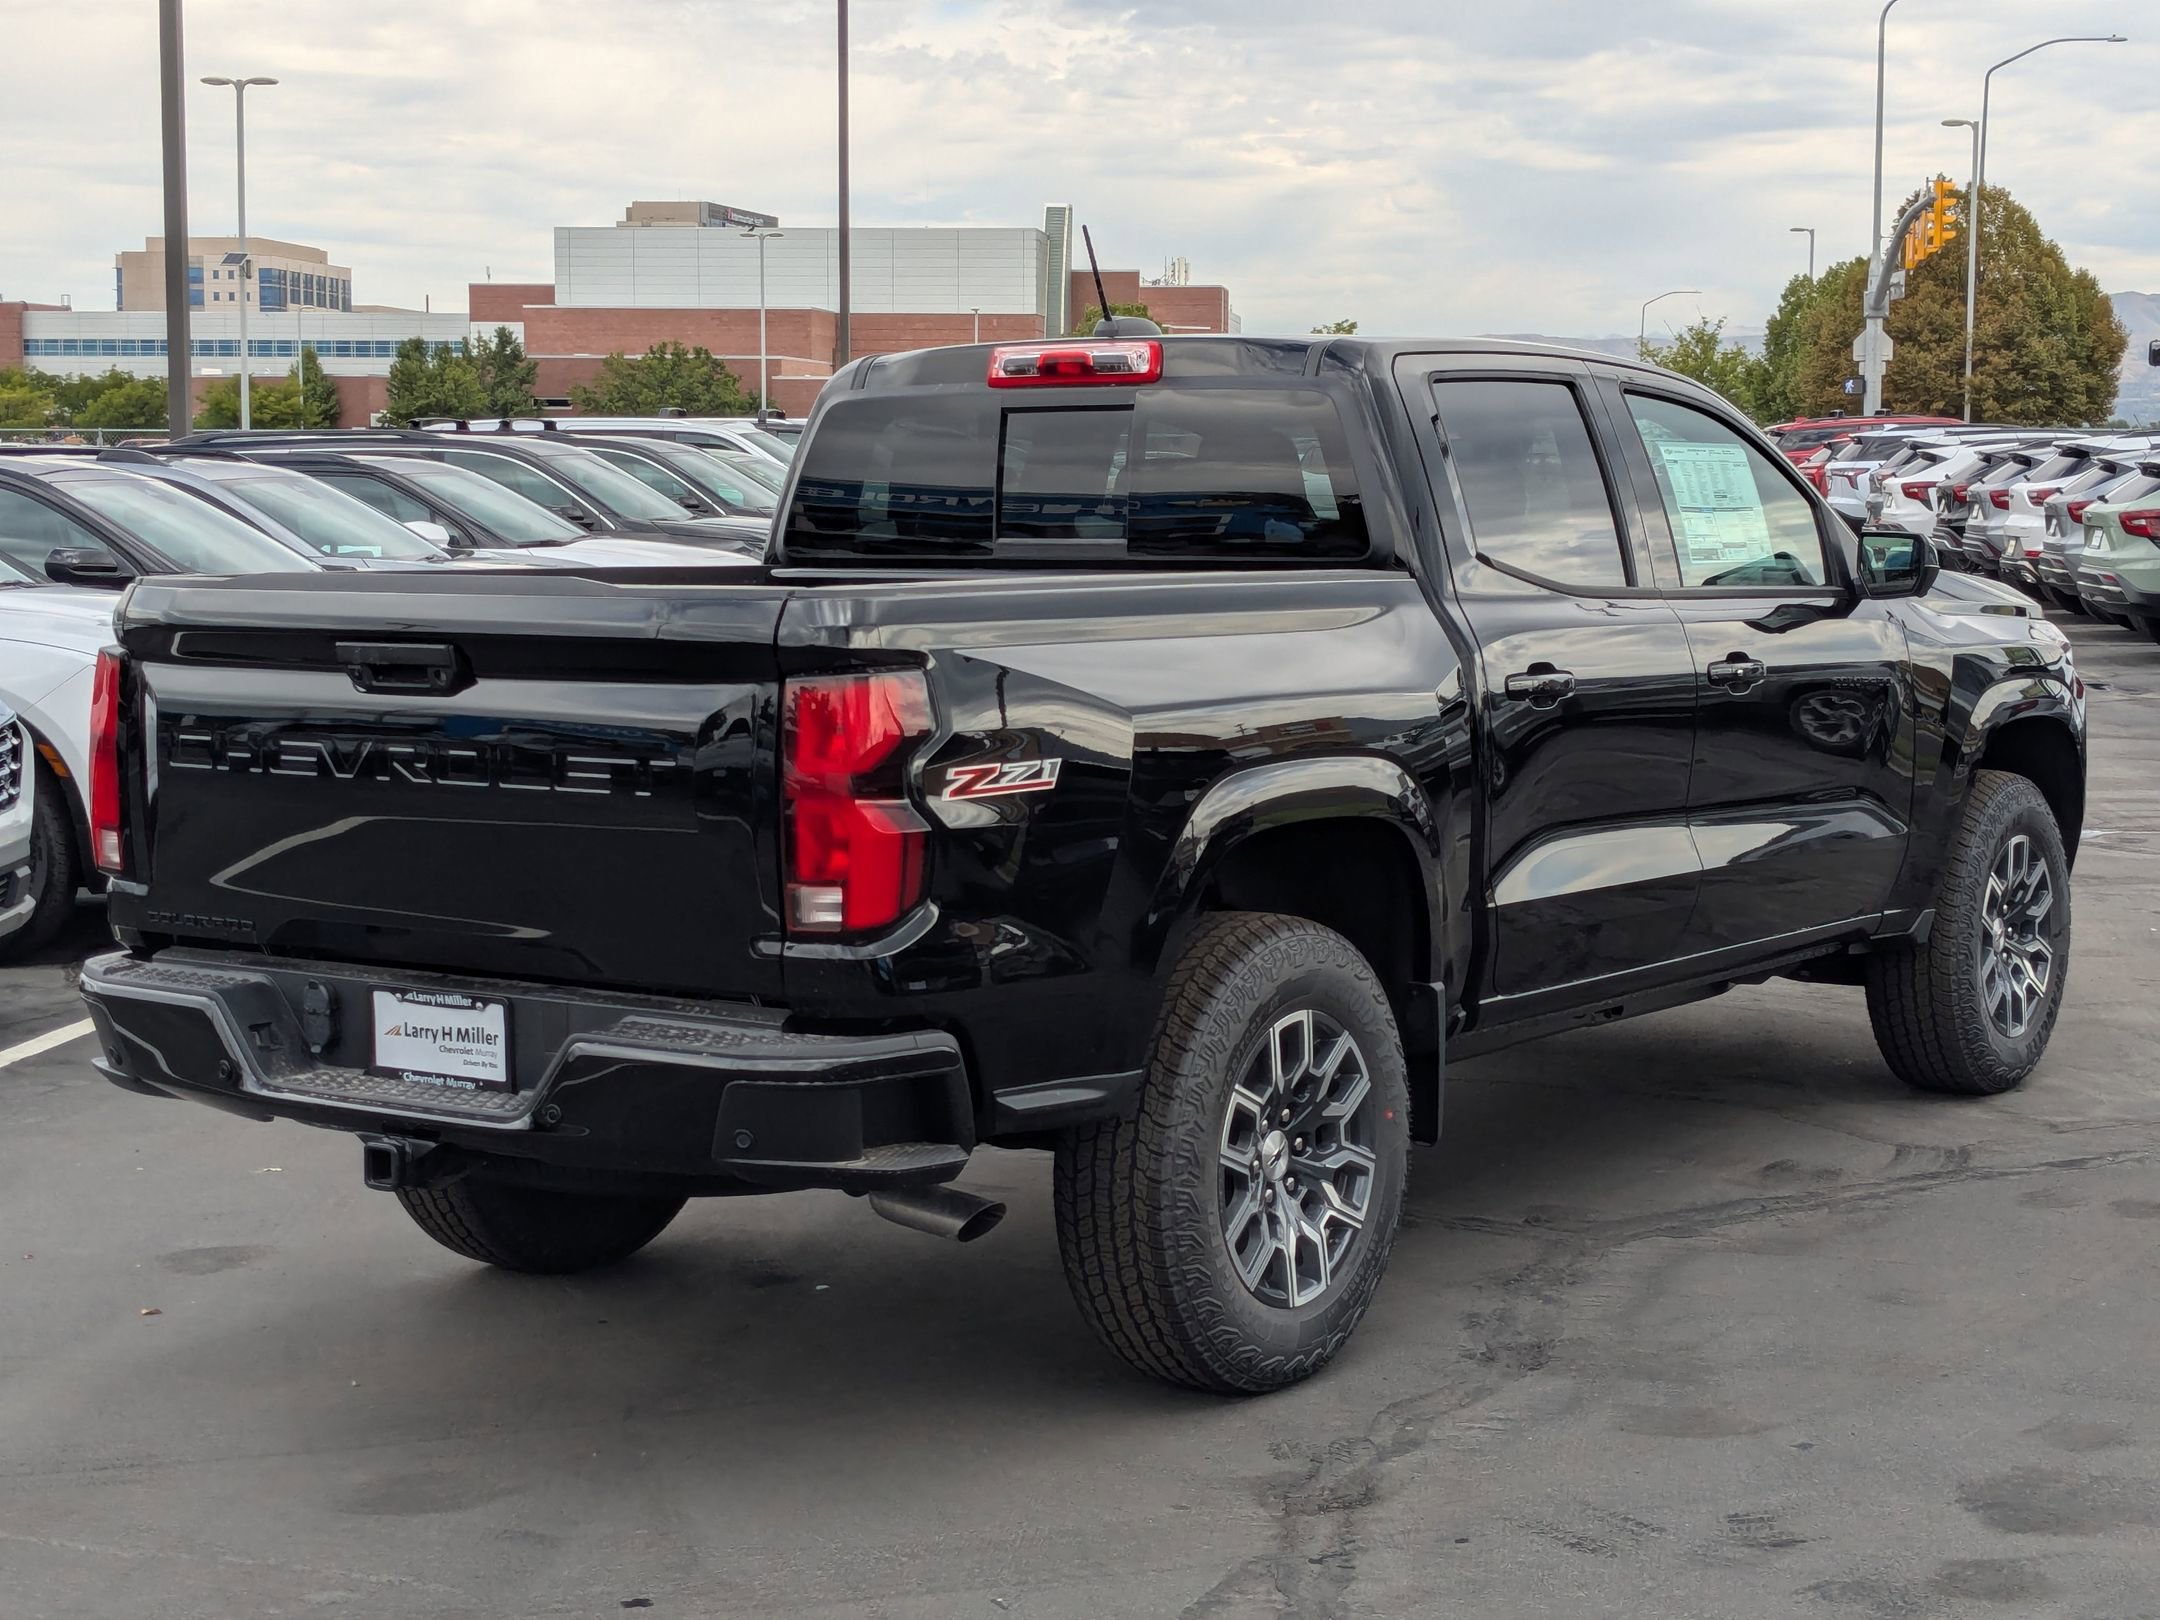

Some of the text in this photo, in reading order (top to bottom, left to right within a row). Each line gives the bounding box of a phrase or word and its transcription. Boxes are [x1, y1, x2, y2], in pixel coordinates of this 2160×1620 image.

[168, 731, 677, 798] CHEVROLET
[942, 757, 1062, 802] Z71
[413, 991, 472, 1007] Larry H Miller
[404, 1022, 499, 1046] Larry H Miller
[439, 1045, 498, 1059] Chevrolet Murray
[402, 1071, 476, 1089] Chevrolet Murray
